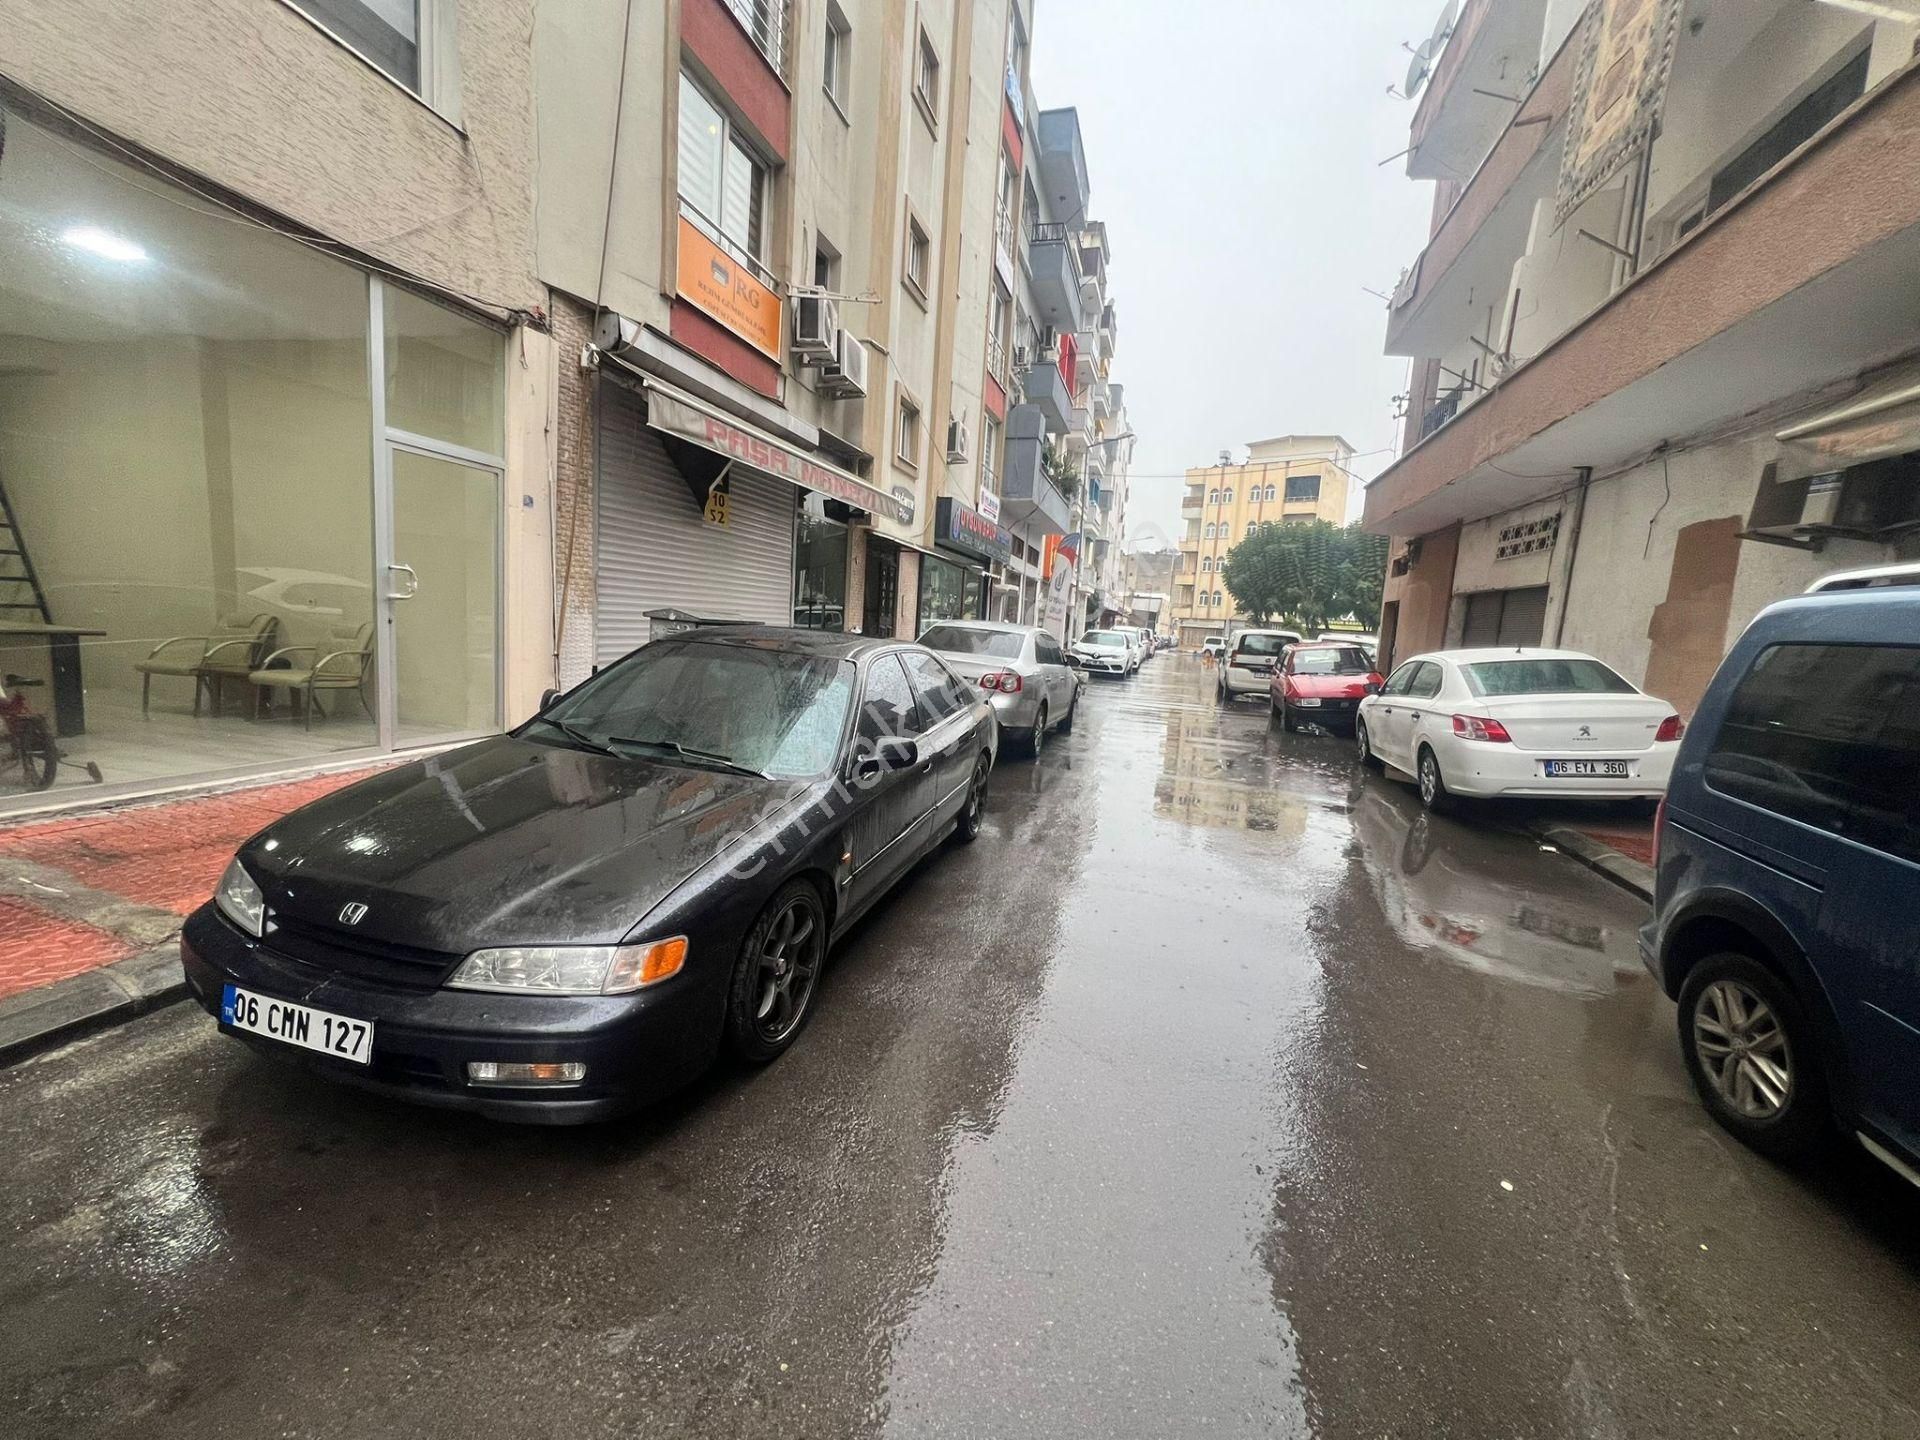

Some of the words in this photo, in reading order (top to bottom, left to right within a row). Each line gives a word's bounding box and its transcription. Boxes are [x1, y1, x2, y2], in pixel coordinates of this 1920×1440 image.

[736, 275, 760, 309] RG
[711, 493, 725, 507] 10
[1553, 762, 1568, 773] 06
[1575, 762, 1597, 773] EYA
[1603, 762, 1625, 773] 360
[234, 992, 259, 1027] 06
[268, 1004, 310, 1042] CMN
[323, 1017, 366, 1056] 127
